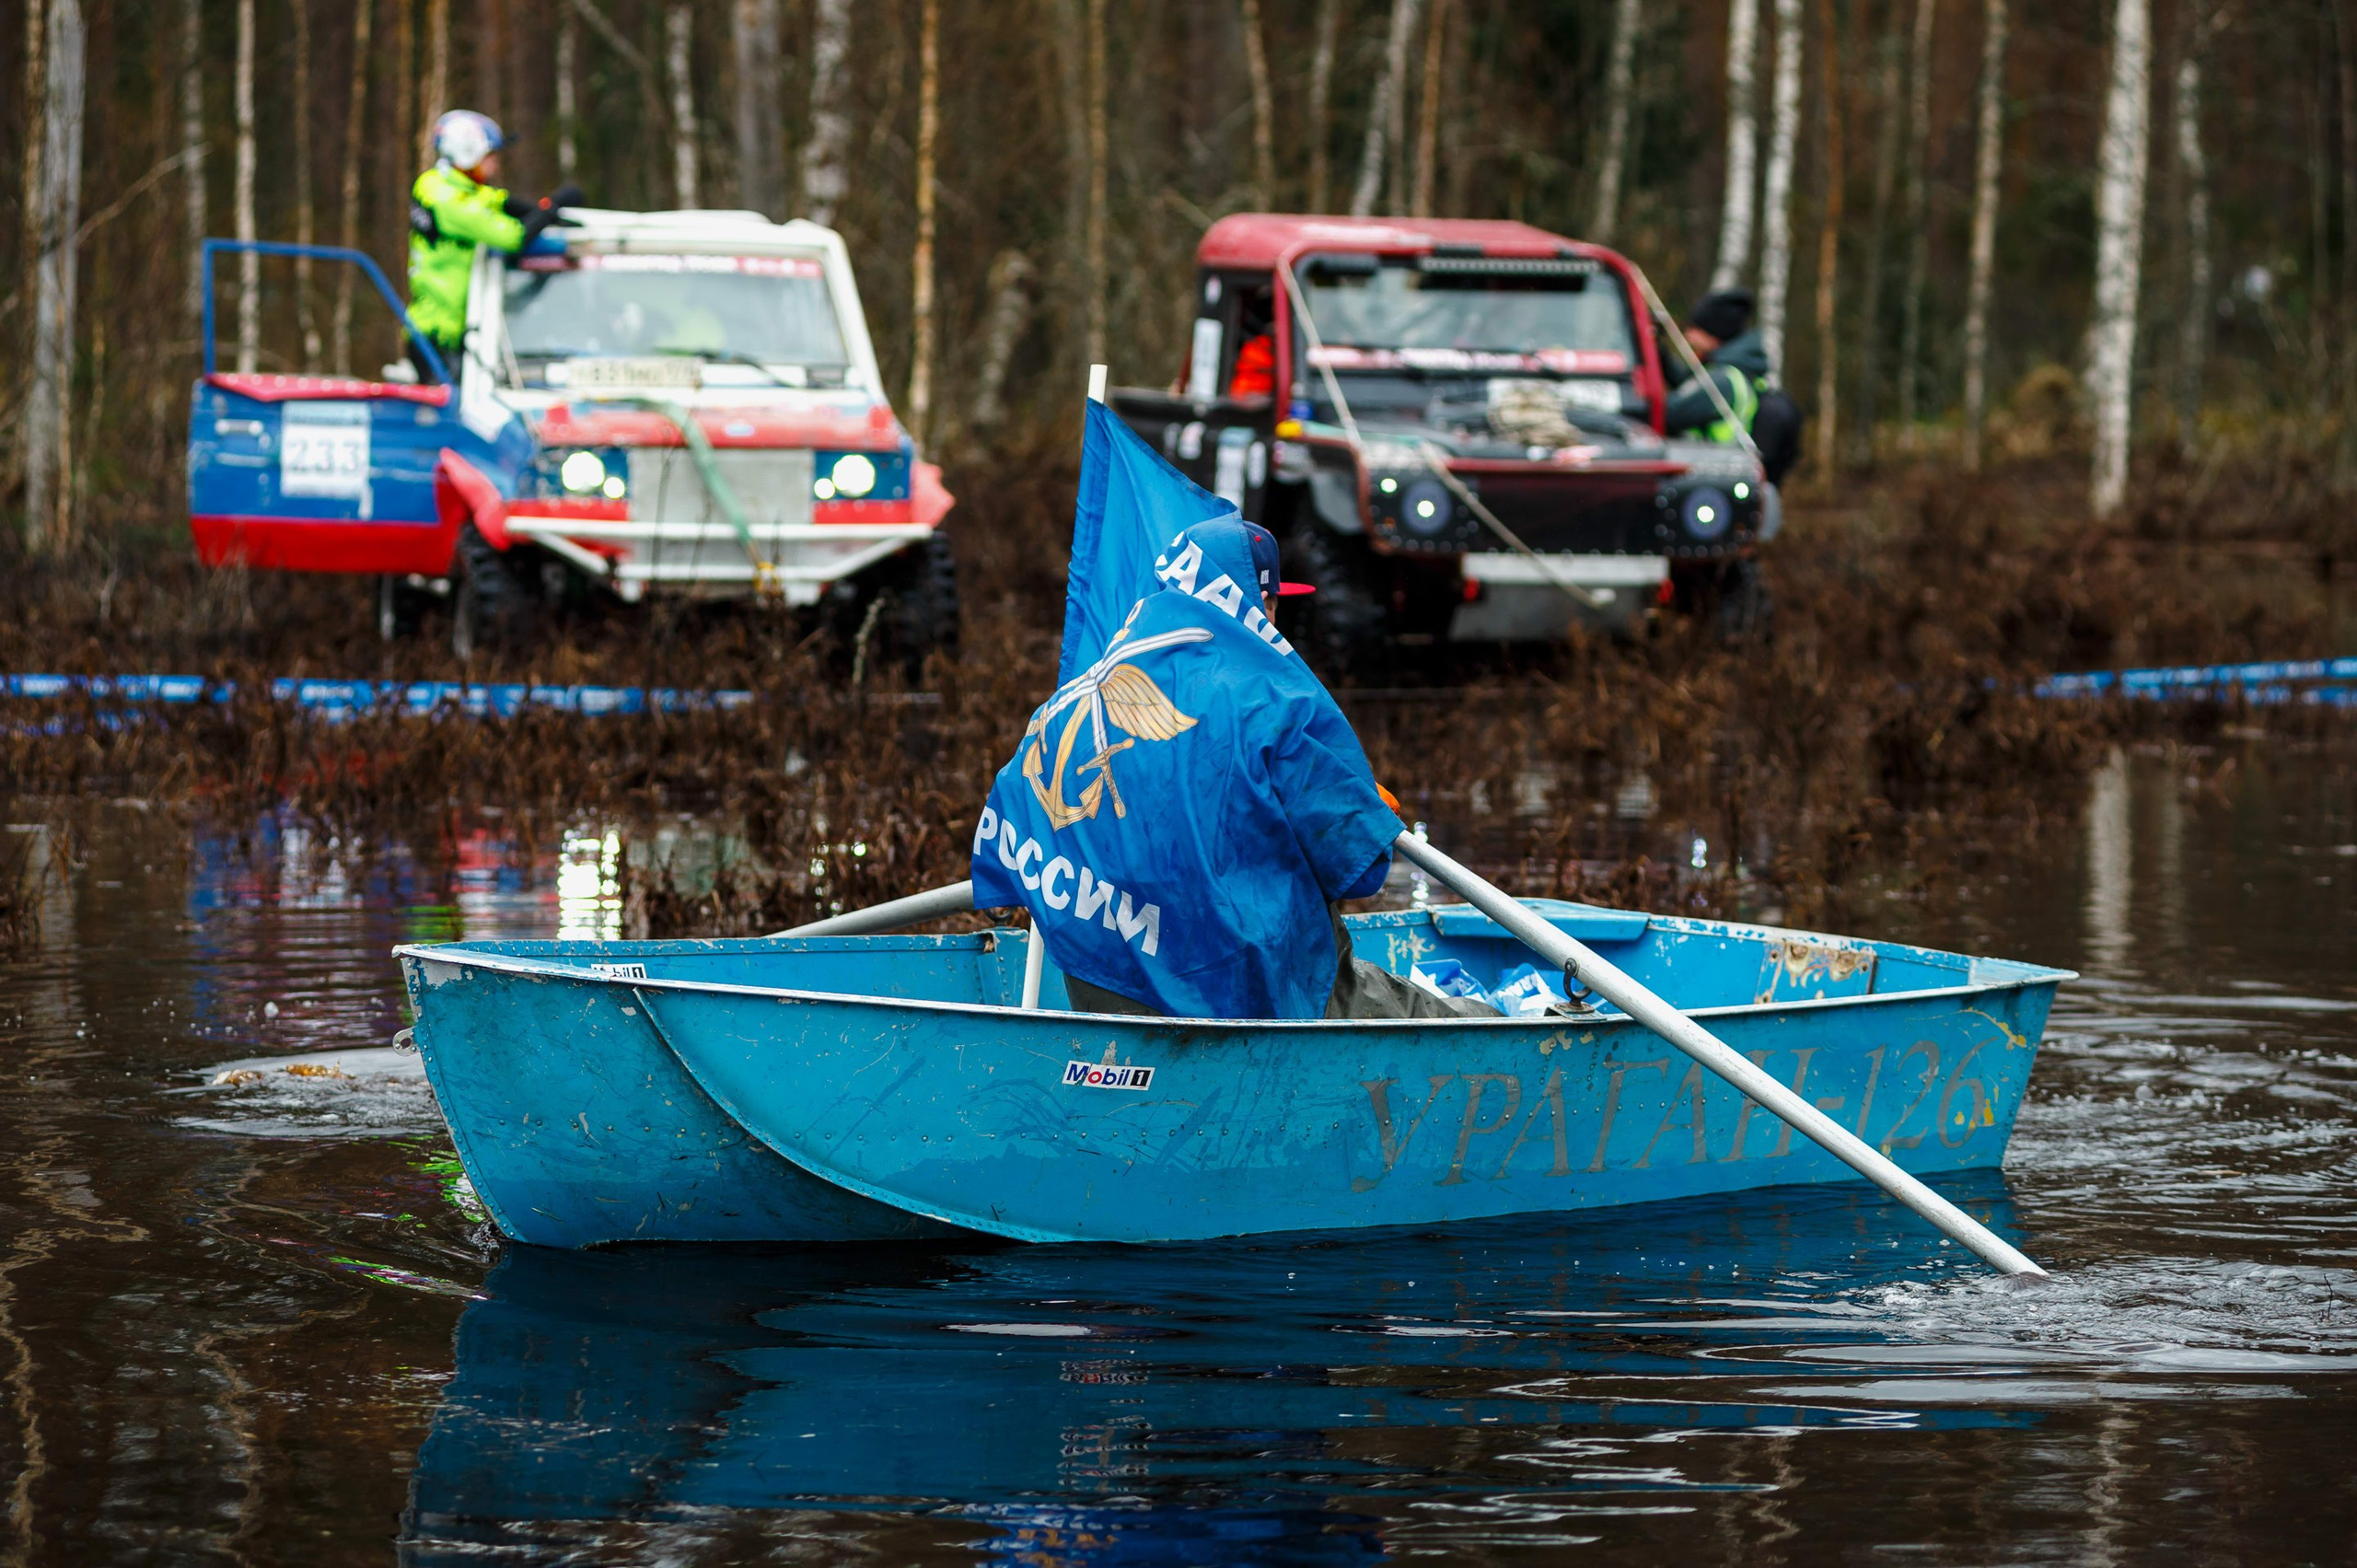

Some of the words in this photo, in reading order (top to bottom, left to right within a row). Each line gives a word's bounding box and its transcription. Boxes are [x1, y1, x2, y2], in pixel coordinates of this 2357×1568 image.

[286, 438, 360, 473] 233
[973, 806, 1160, 957] РОССИИ
[1066, 1063, 1131, 1086] Mobil
[1132, 1070, 1150, 1086] 1
